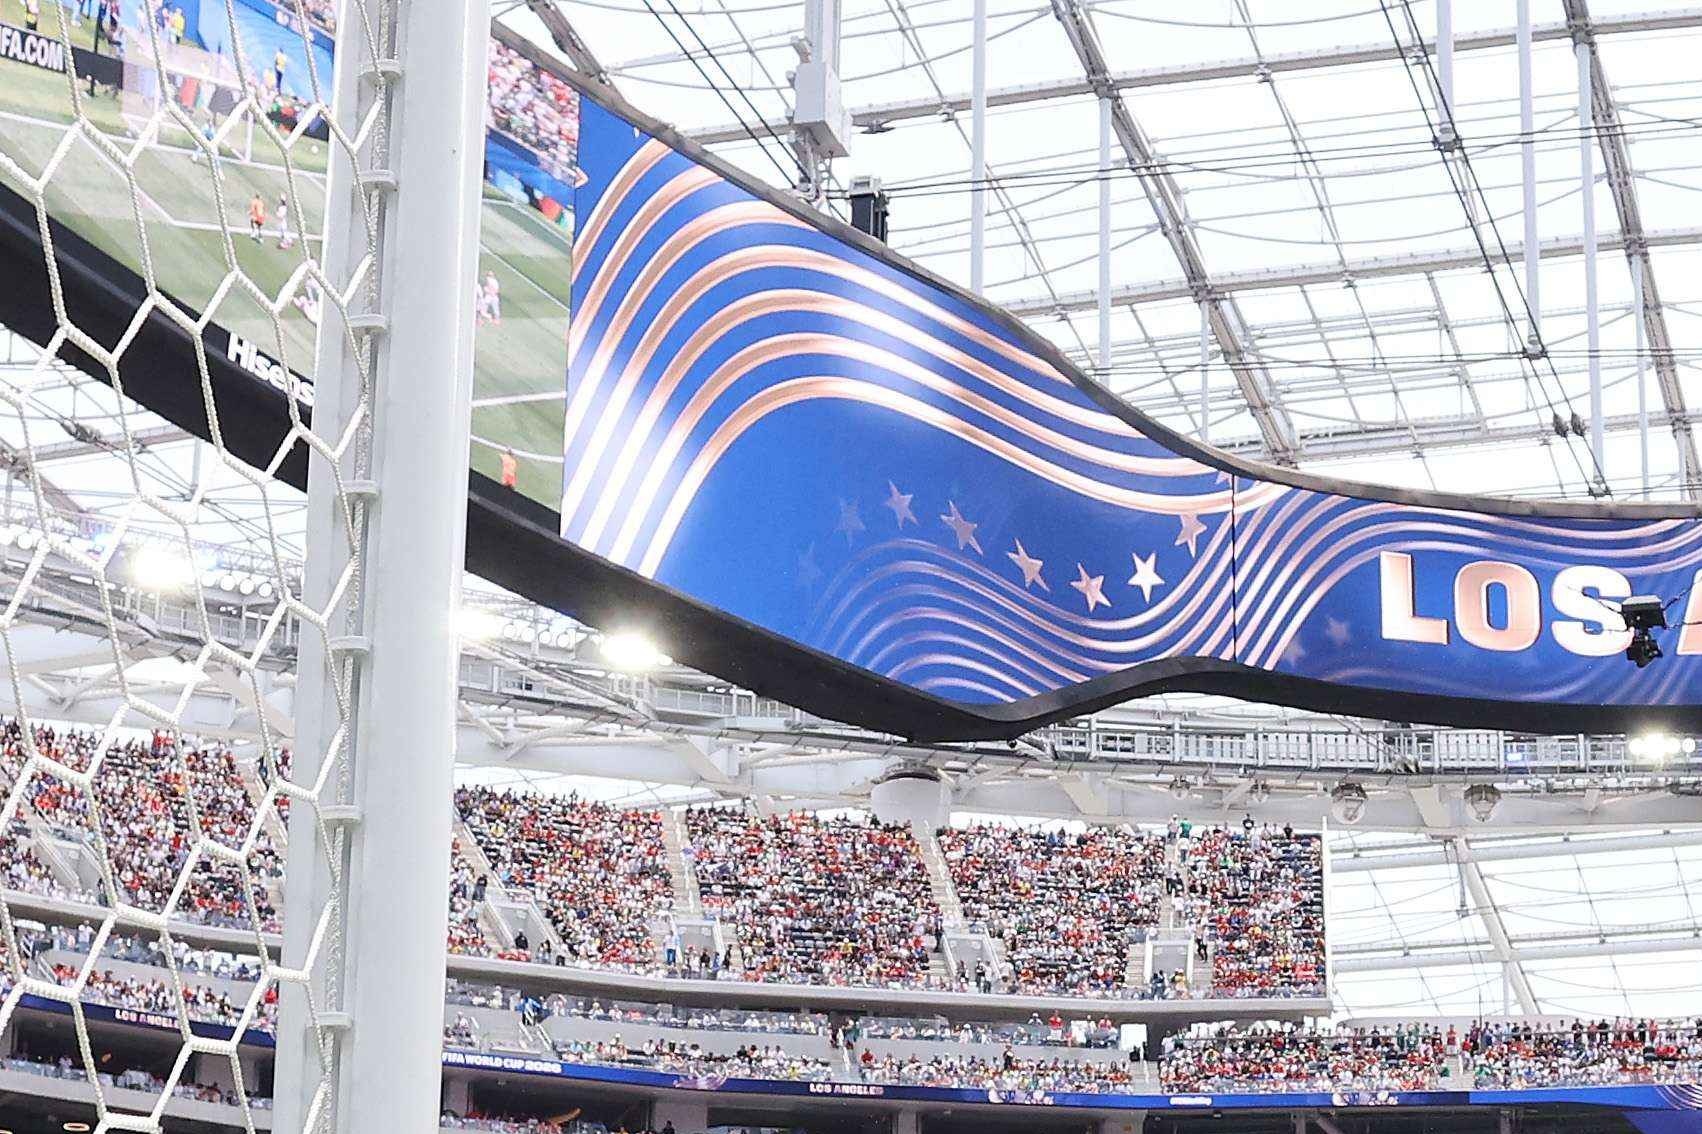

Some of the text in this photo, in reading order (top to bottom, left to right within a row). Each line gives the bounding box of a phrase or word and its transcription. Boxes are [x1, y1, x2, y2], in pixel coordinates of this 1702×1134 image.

[1380, 550, 1630, 656] LOS
[465, 1053, 502, 1067] WORLD
[504, 1058, 524, 1070] CUP
[810, 1083, 884, 1096] LOS ANGELES
